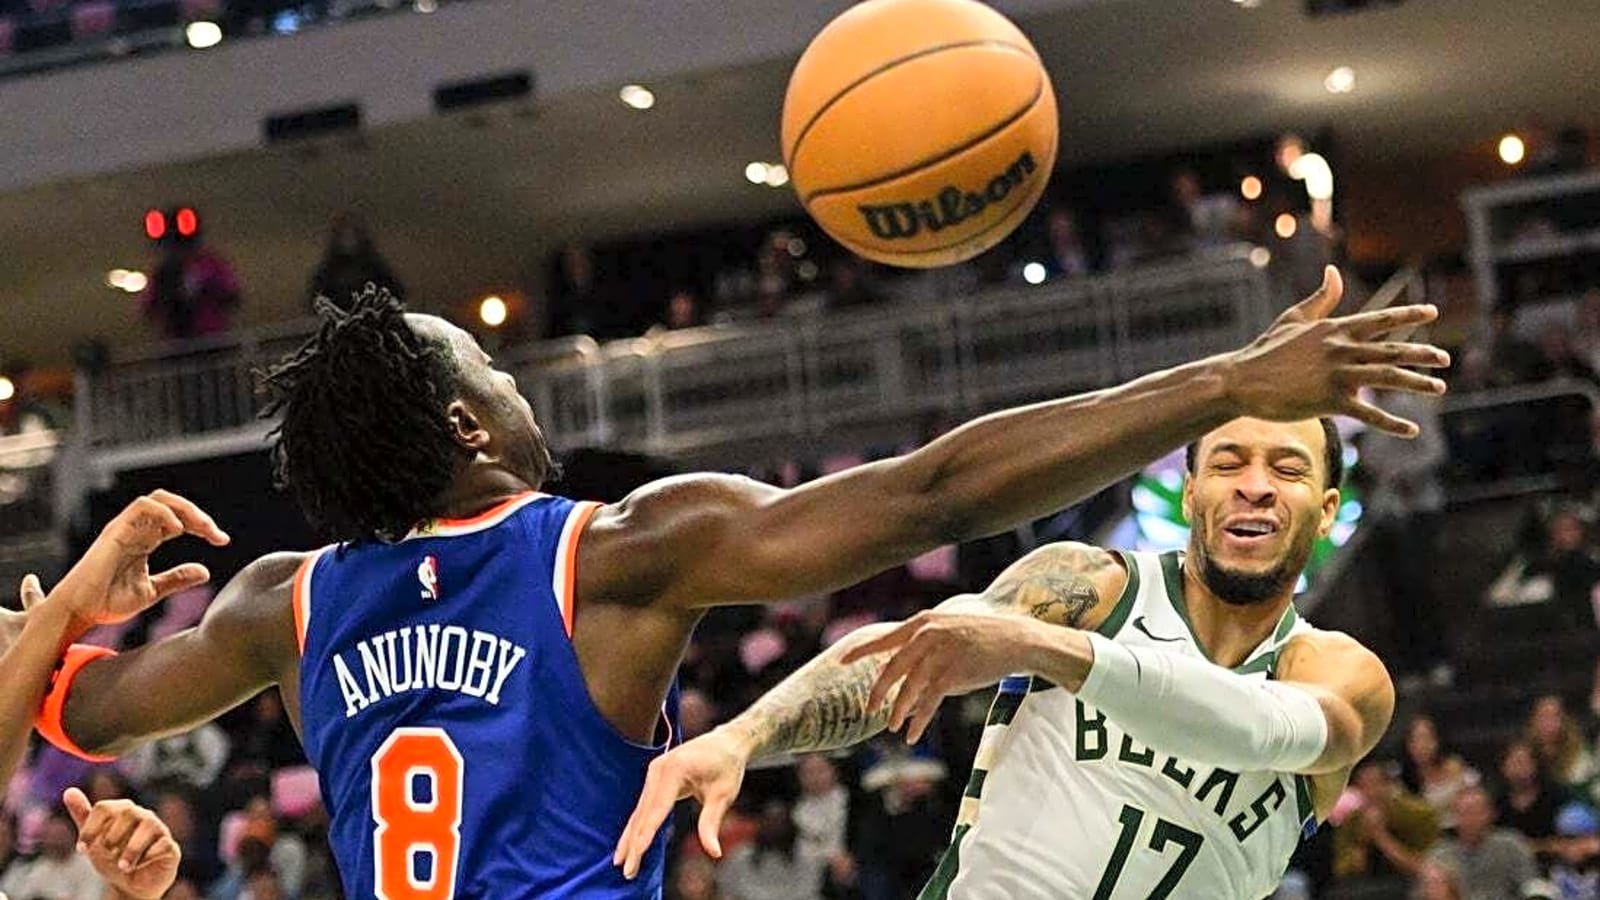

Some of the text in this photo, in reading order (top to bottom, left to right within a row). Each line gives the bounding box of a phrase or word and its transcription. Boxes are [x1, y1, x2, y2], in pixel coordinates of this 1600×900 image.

[858, 151, 1037, 239] Wilson
[332, 624, 526, 718] ANUNOBY
[371, 727, 464, 900] 8
[1092, 804, 1205, 900] 17
